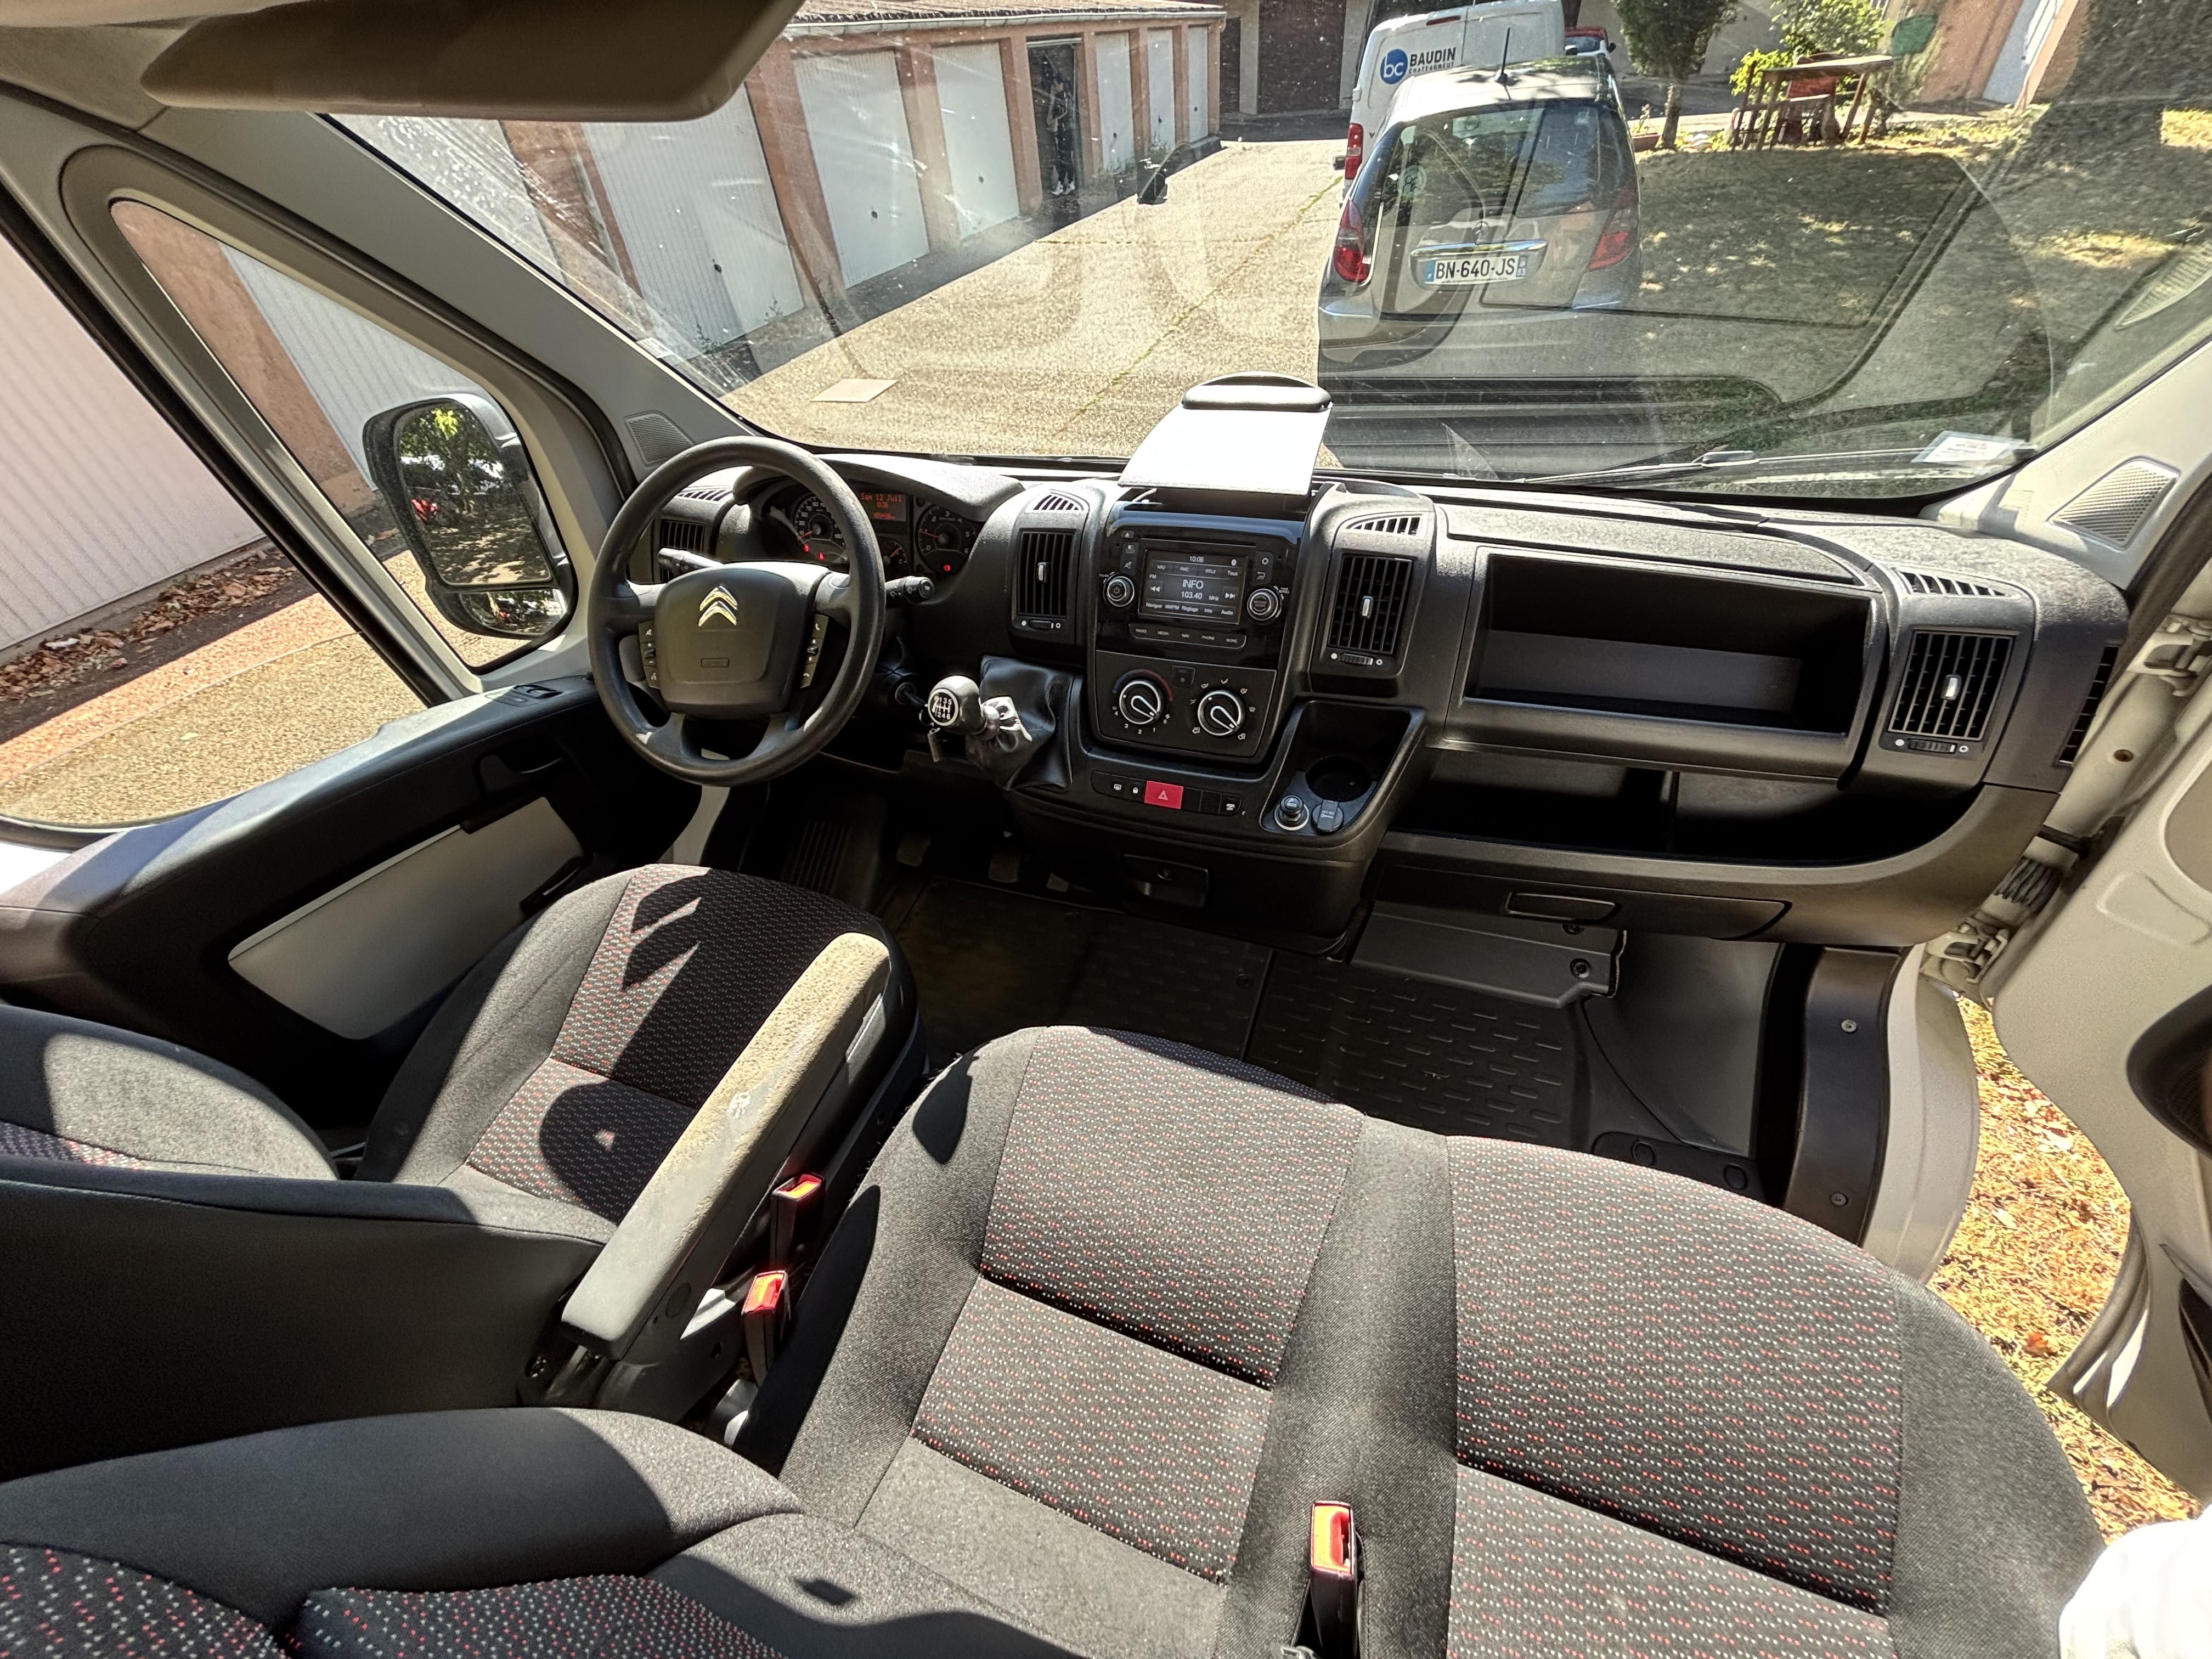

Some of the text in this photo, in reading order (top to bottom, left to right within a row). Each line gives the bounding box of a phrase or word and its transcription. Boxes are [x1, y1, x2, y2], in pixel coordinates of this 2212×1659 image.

[1410, 47, 1456, 67] BAUDIN
[1383, 54, 1404, 78] bc
[1182, 579, 1204, 589] INFO
[1181, 591, 1203, 599] 103.40
